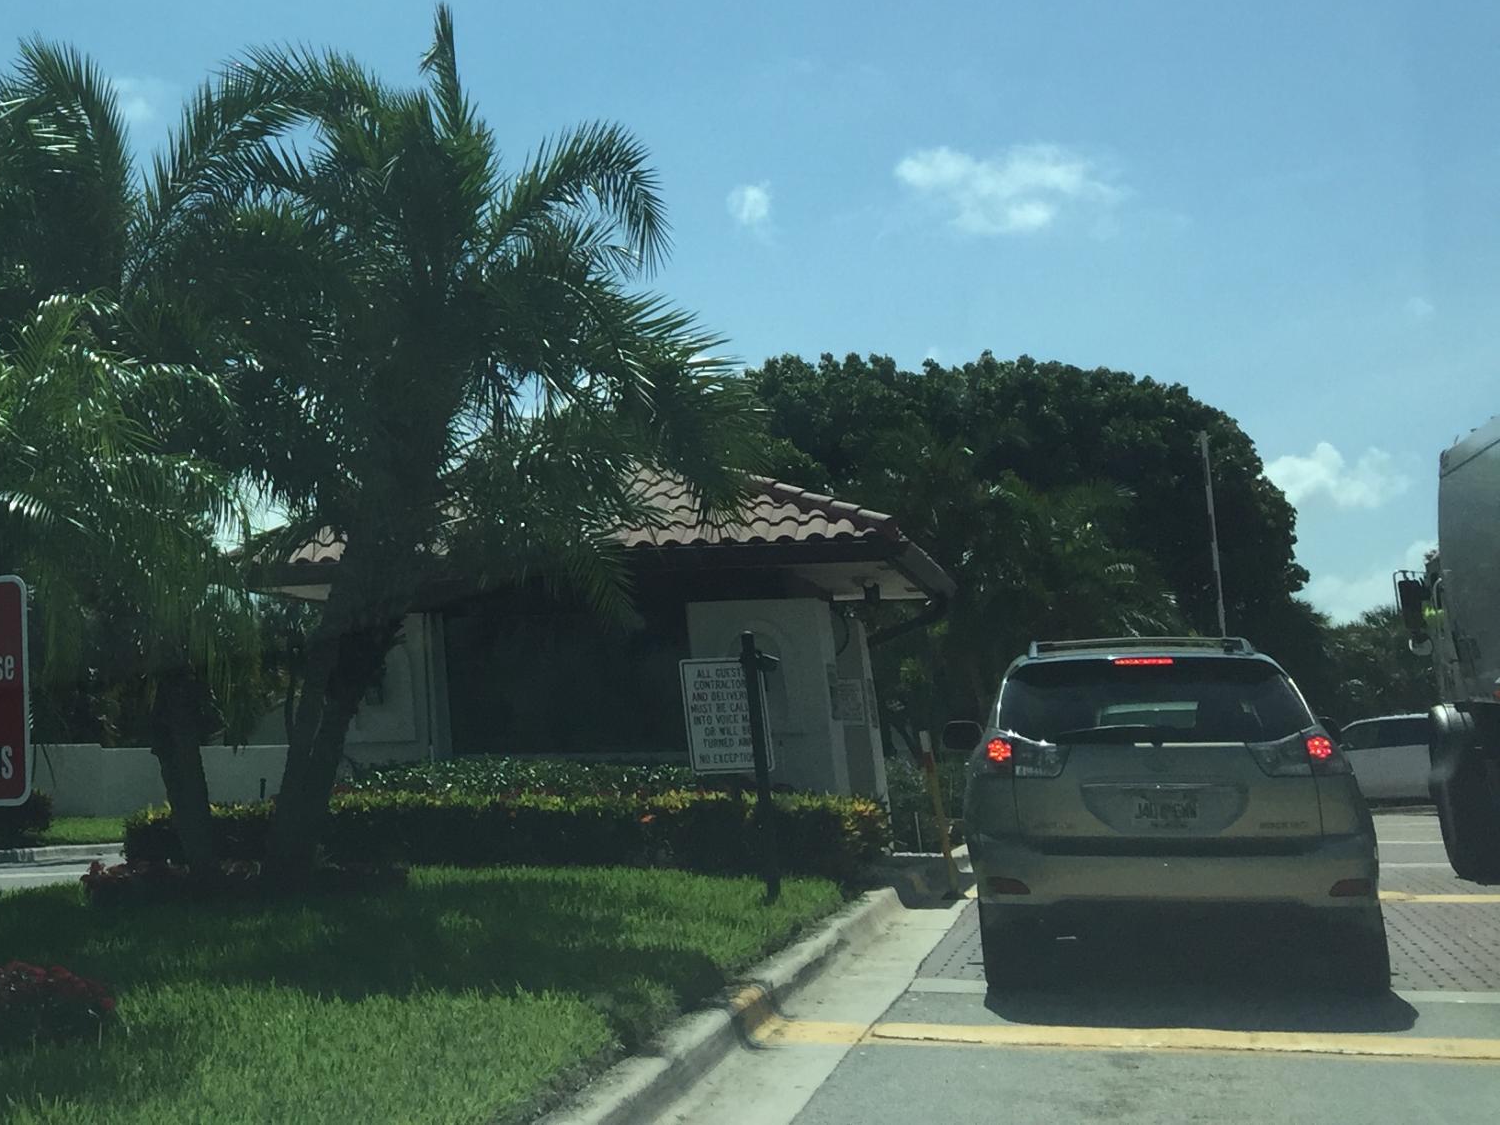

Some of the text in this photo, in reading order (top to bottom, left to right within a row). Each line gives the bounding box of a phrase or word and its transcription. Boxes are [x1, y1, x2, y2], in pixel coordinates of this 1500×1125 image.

[697, 668, 712, 679] ALL
[692, 692, 708, 702] AND
[690, 703, 712, 713] MUST
[716, 702, 726, 713] BE
[693, 714, 713, 725] INTO
[715, 714, 739, 724] VOICE
[704, 726, 717, 736] OR
[703, 737, 735, 748] TURNED
[699, 753, 710, 764] NO
